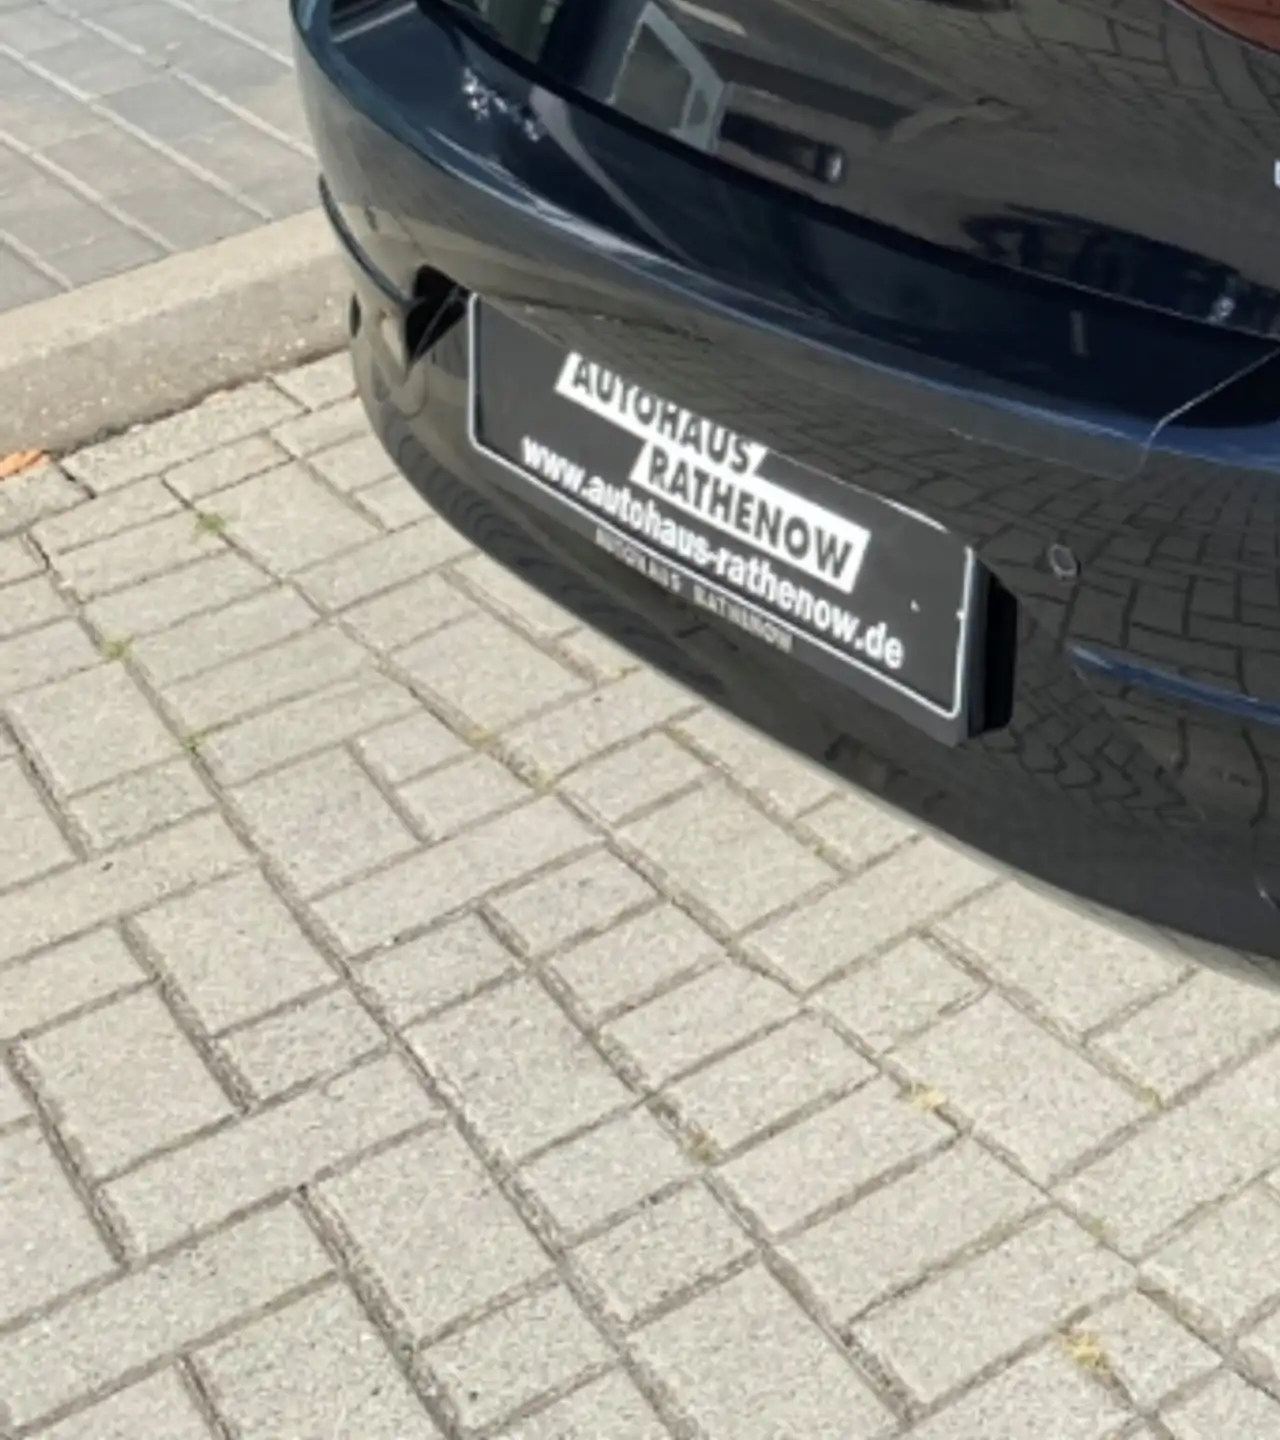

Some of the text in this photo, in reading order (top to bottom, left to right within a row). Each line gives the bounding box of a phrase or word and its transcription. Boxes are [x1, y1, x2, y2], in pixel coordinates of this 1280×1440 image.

[572, 355, 752, 472] AUTOHAUS
[522, 436, 904, 669] www.autohaus-rathenow.de
[648, 443, 854, 579] RATHENOW
